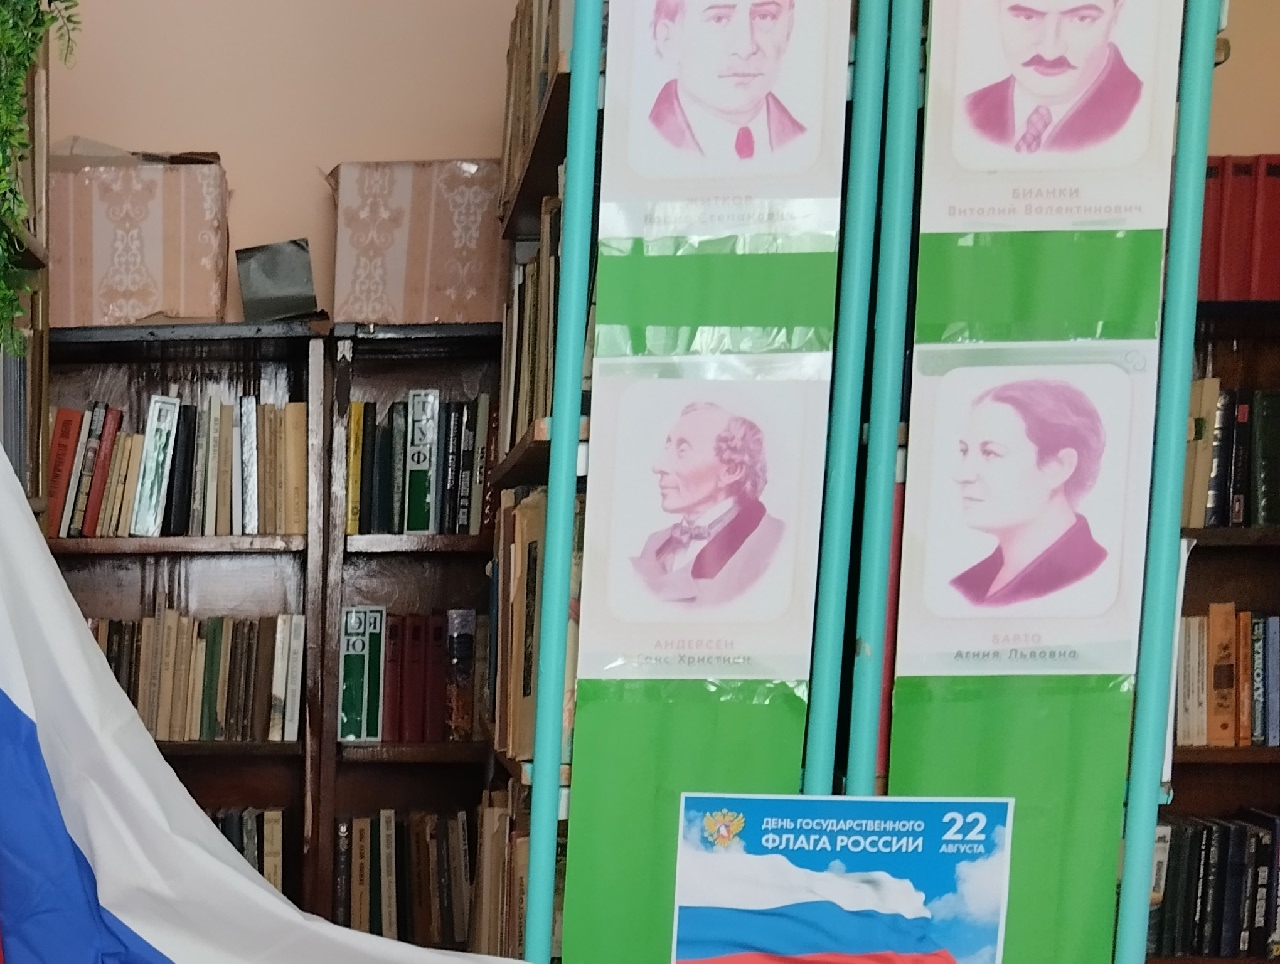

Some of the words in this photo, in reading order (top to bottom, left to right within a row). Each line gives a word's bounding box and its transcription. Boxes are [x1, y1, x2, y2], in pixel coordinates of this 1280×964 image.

[1012, 188, 1080, 200] БИАНКИ
[948, 205, 1016, 217] Виталий
[1024, 203, 1143, 216] Валентинович
[654, 639, 735, 650] АНДЕРСЕН
[992, 634, 1041, 644] БАРТО
[954, 649, 1000, 660] Агния
[1008, 648, 1078, 660] Львовна
[762, 817, 795, 830] ДЕНЬ
[796, 818, 925, 833] ГОСУДАРСТВЕННОГО
[941, 812, 987, 841] 22
[762, 832, 831, 852] ФЛАГА
[836, 836, 923, 853] РОССИИ
[939, 843, 985, 854] АВГУСТА
